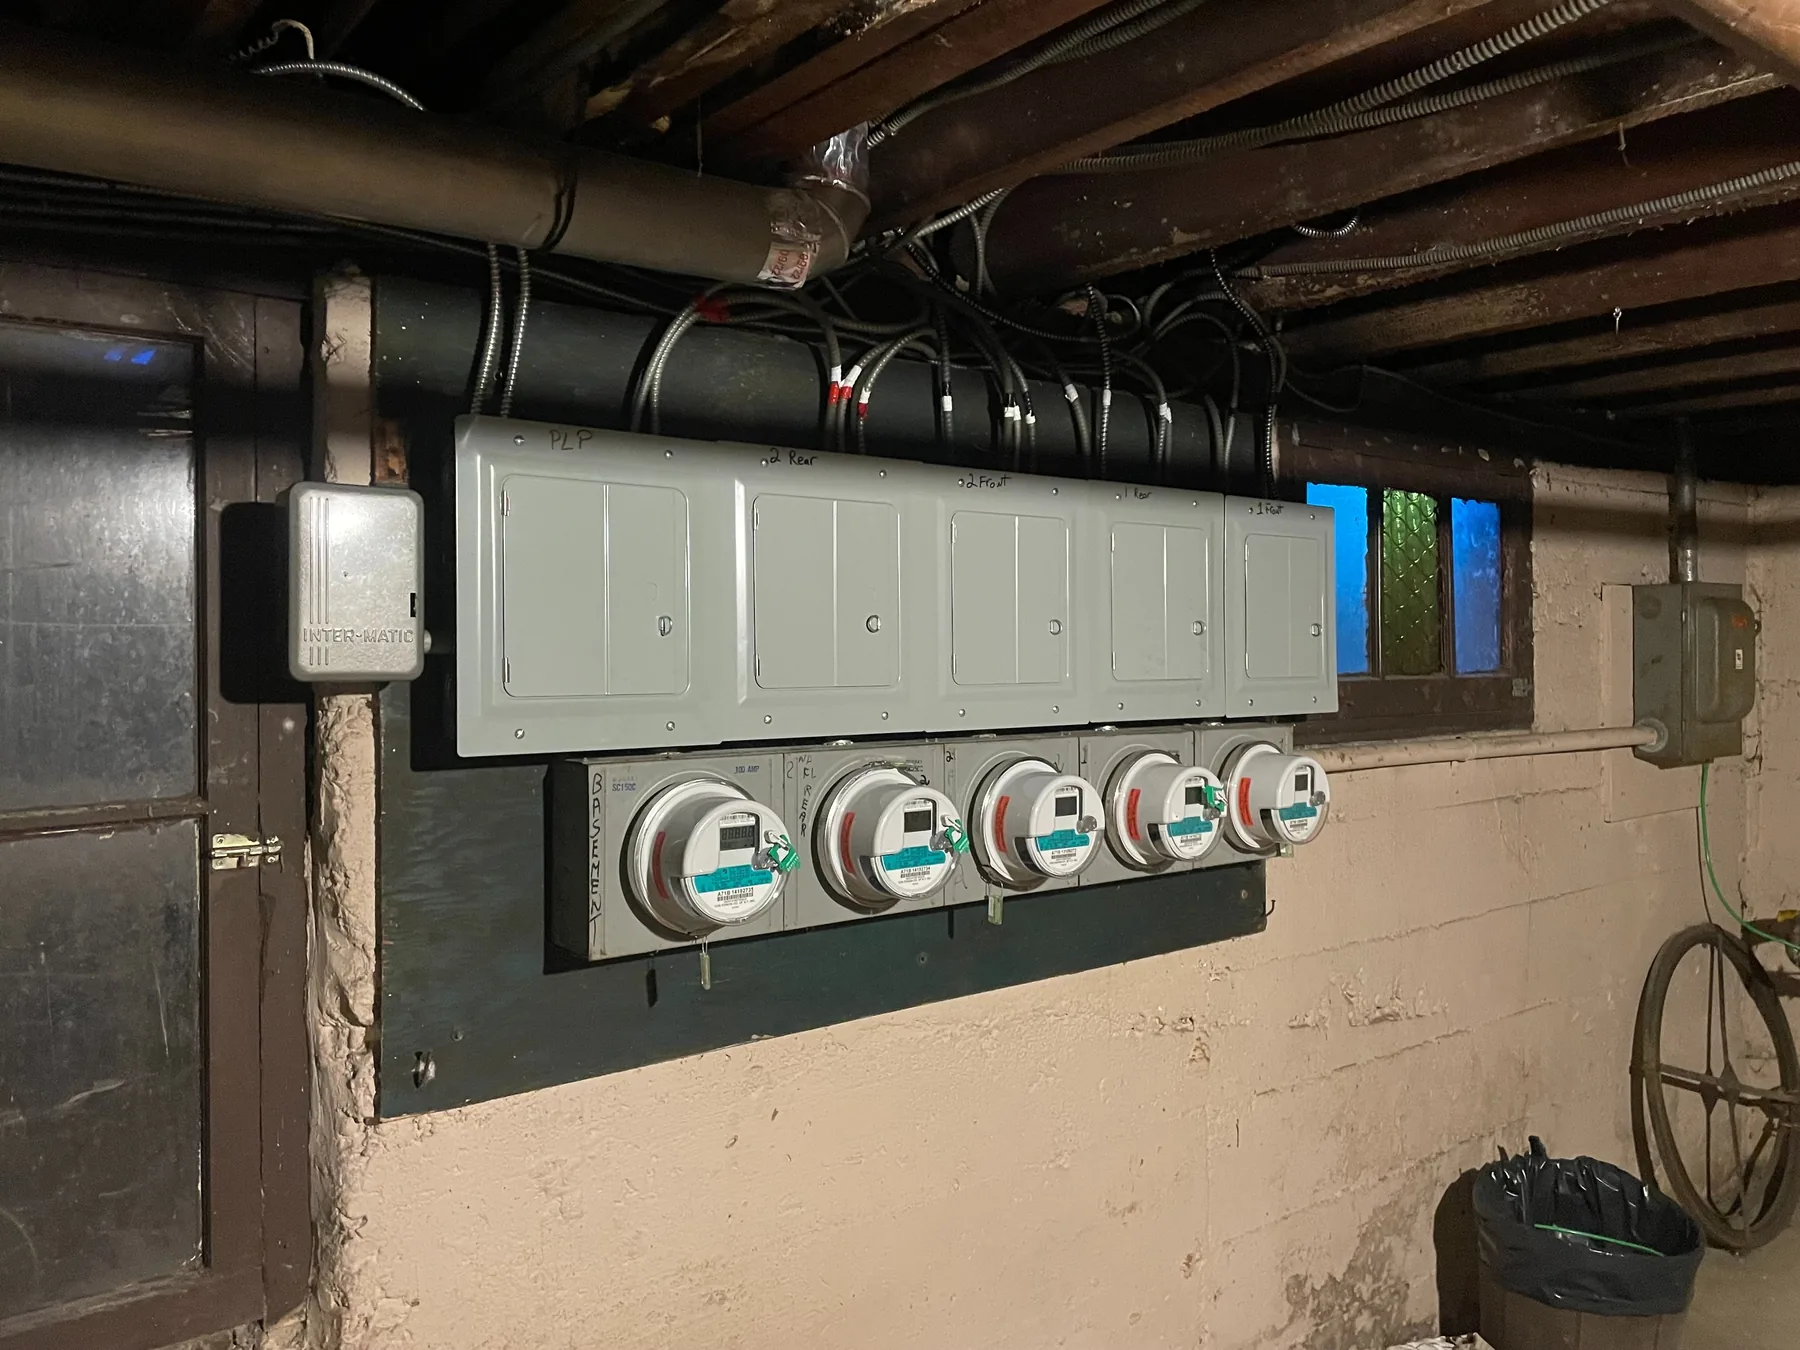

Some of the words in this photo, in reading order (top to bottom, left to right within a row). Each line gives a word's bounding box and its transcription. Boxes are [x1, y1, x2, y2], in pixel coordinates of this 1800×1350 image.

[549, 429, 593, 450] PLP
[769, 447, 781, 464] 2
[788, 450, 818, 466] Rear
[966, 473, 978, 488] 2
[979, 472, 1012, 489] Front
[1256, 501, 1264, 516] 1
[303, 627, 414, 643] INTER-MATIC
[919, 774, 930, 786] 2
[589, 772, 603, 947] BASEMENT
